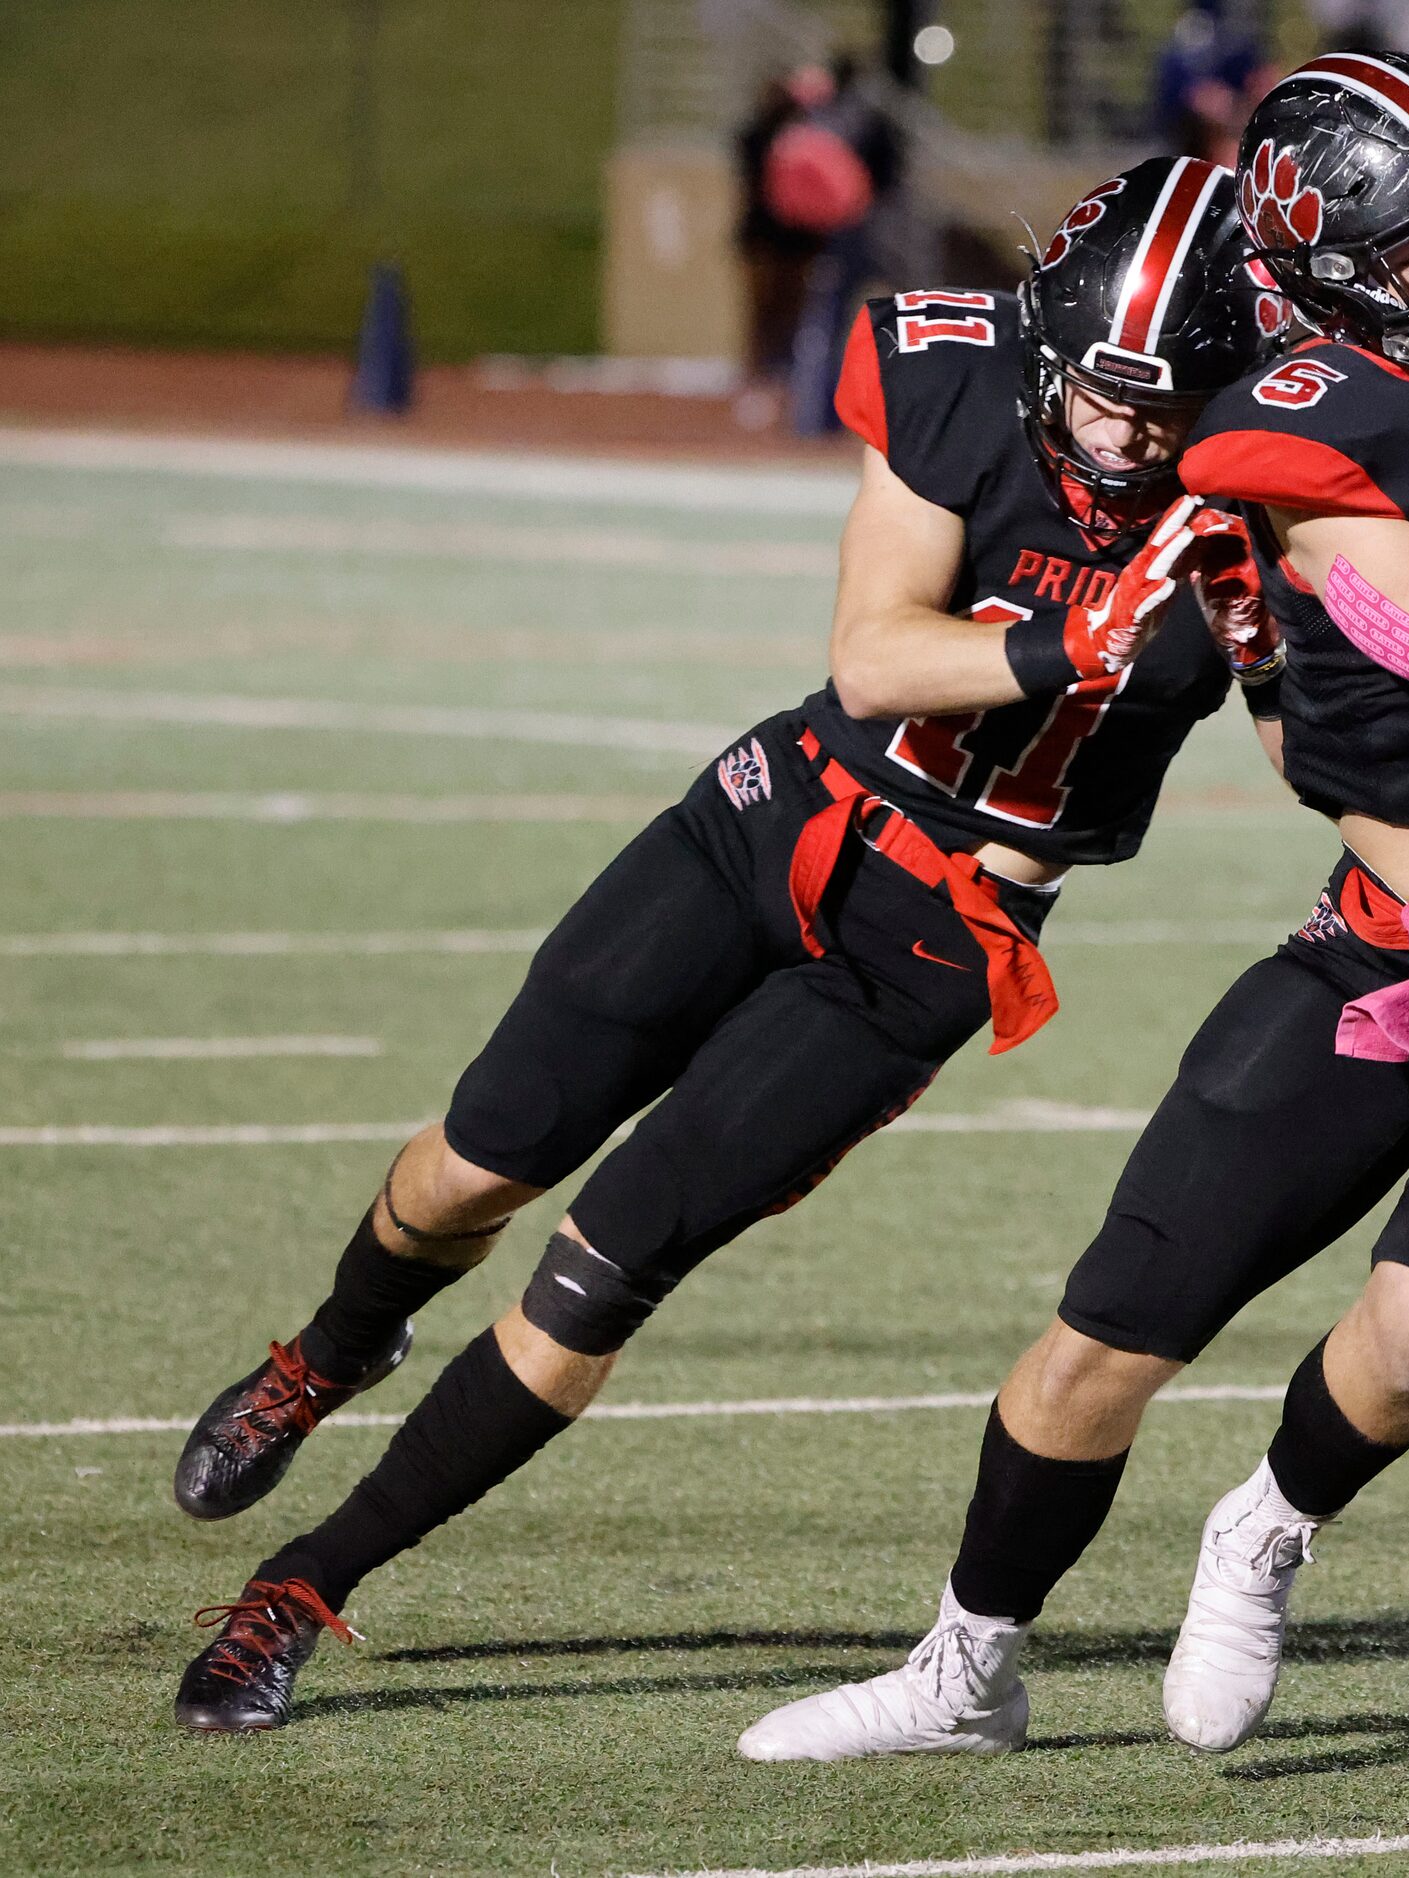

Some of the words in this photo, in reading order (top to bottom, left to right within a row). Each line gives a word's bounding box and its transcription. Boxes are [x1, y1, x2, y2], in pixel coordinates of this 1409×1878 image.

[894, 289, 995, 354] 11
[1251, 358, 1349, 410] 5
[1008, 549, 1119, 610] PRID
[1350, 574, 1379, 603] BATTLE
[1357, 602, 1388, 629] BATTLE
